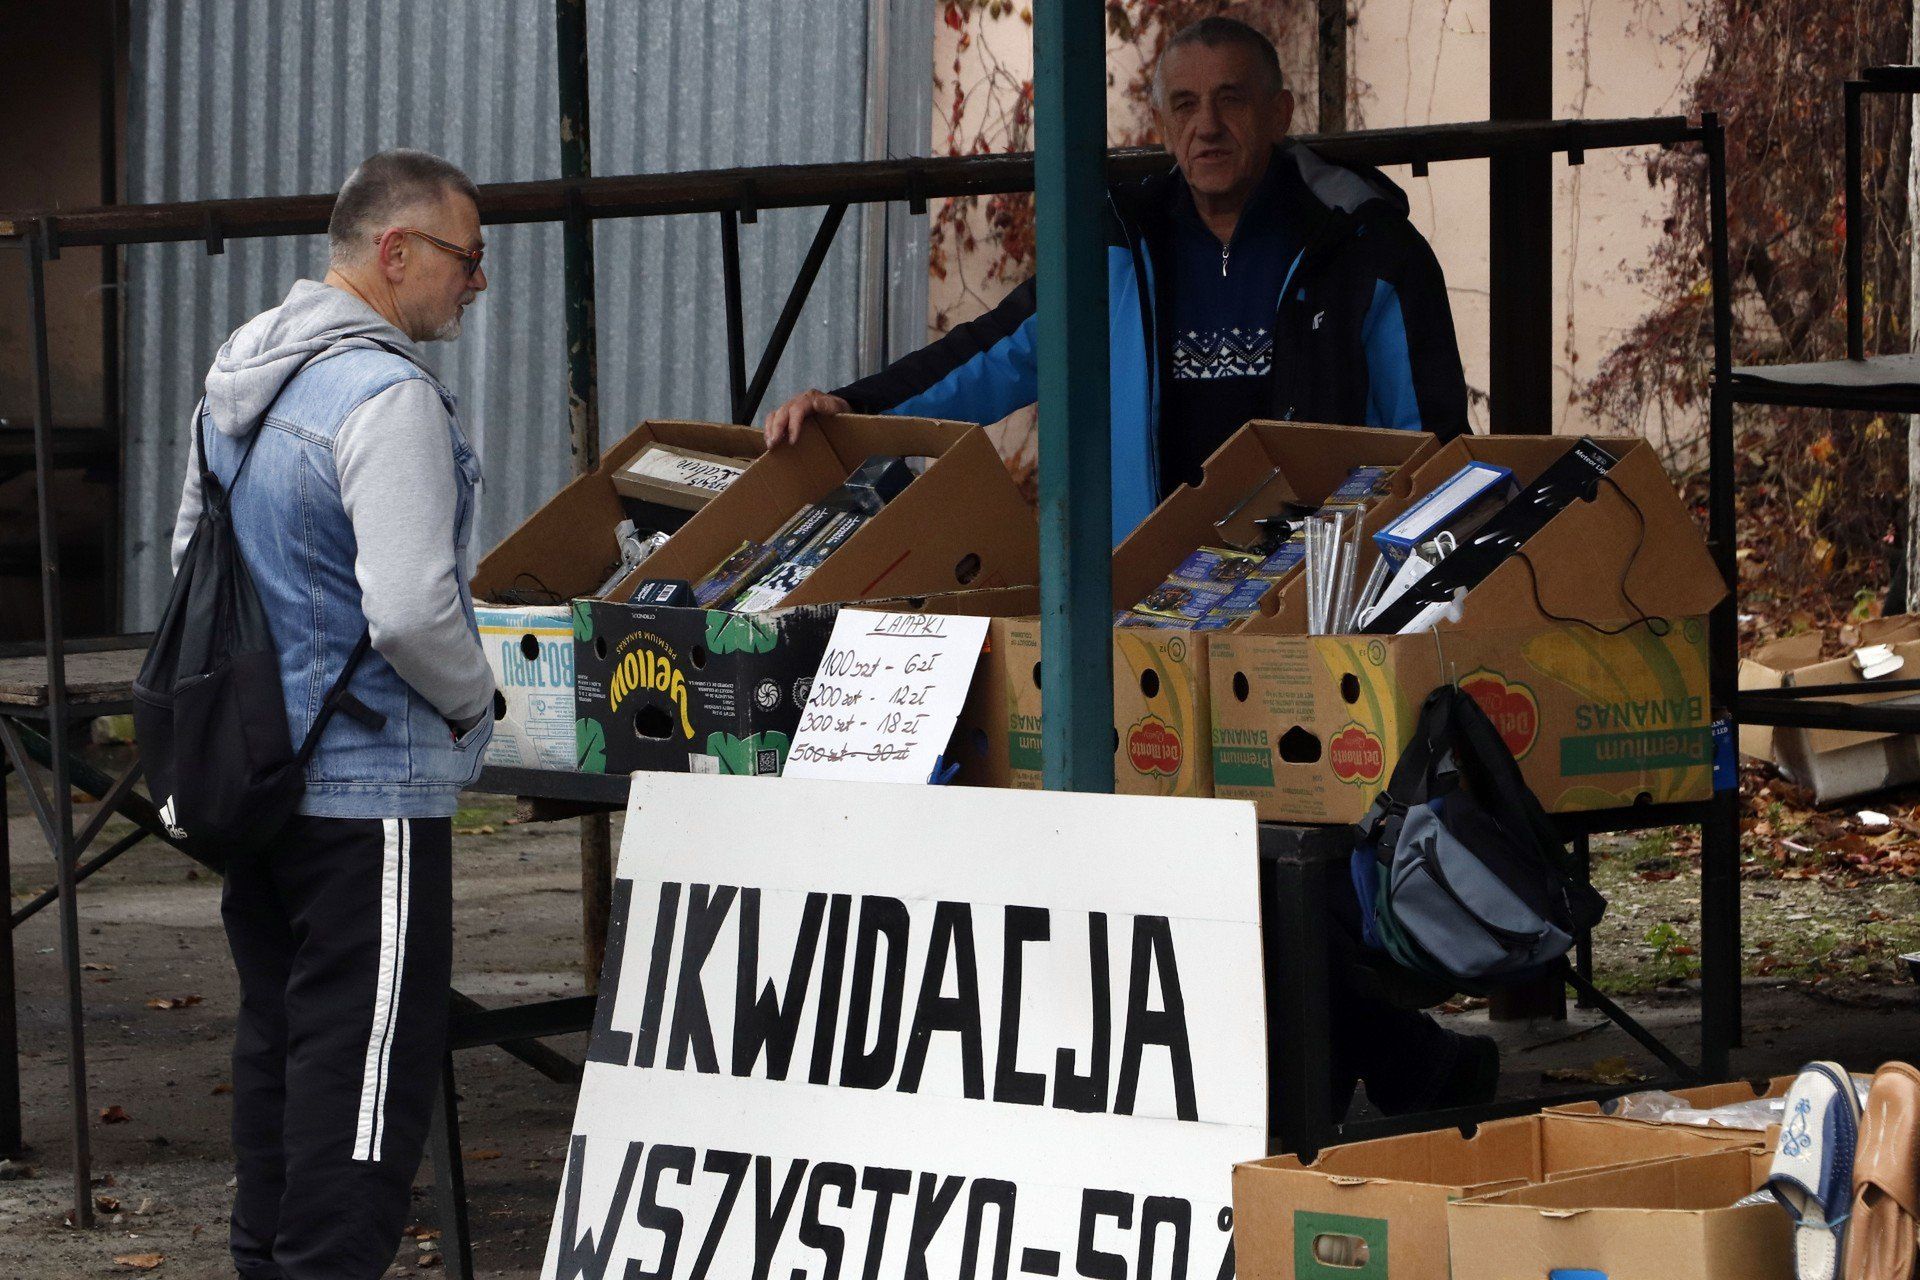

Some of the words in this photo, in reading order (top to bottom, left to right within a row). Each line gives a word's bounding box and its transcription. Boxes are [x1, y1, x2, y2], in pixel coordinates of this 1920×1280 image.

[874, 614, 945, 634] LAMPKI
[615, 630, 643, 655] BANANAS
[644, 631, 678, 661] PREMIUM
[610, 649, 695, 740] yellow
[1010, 715, 1042, 731] ANAS
[1576, 696, 1703, 731] BANANAS
[1212, 728, 1268, 745] BANANAS
[1131, 742, 1162, 760] Monte
[1162, 745, 1179, 760] Del
[1596, 733, 1704, 762] Premium
[1220, 751, 1269, 768] Premium
[1333, 749, 1363, 766] Monte
[1363, 750, 1381, 766] Del
[586, 878, 1199, 1122] LIKWIDACJA
